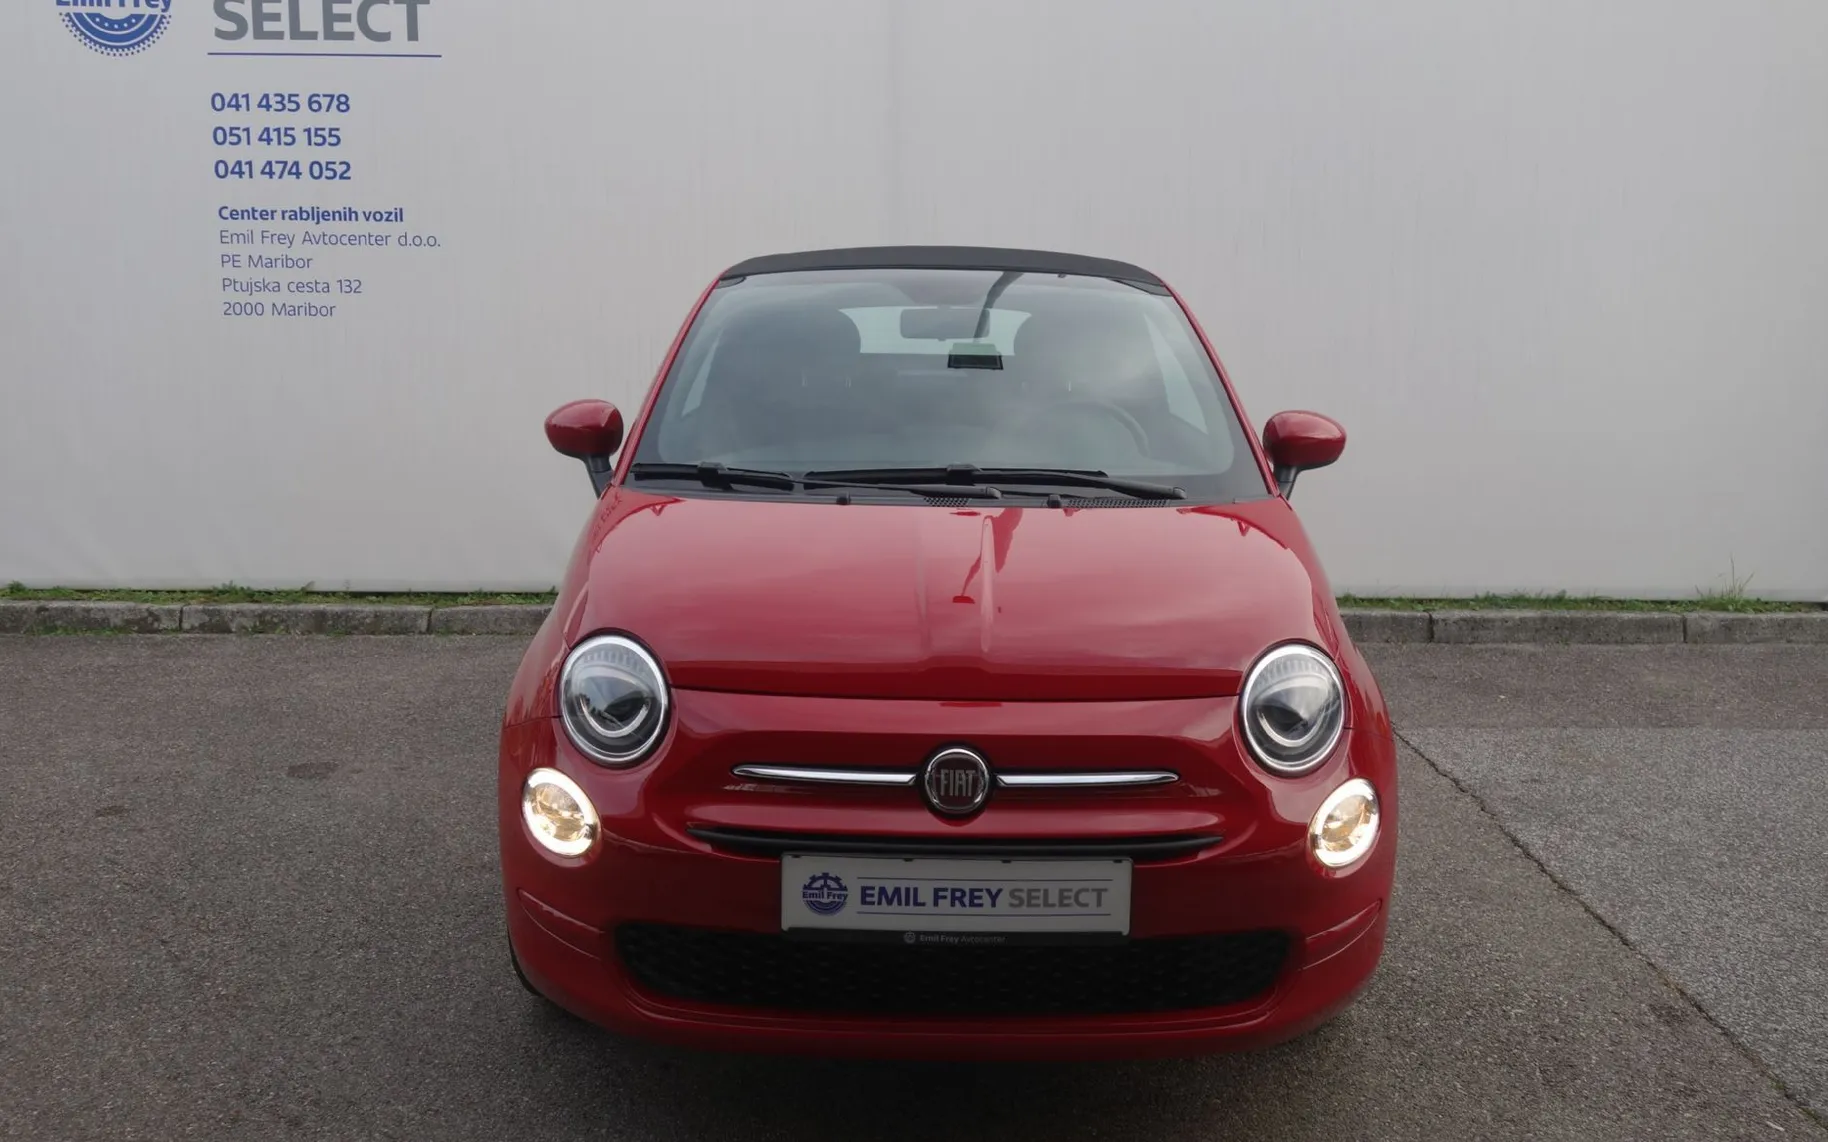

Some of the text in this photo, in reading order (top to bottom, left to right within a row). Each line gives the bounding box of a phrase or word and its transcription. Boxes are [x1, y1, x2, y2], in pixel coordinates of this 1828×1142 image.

[213, 0, 430, 43] SELECT
[210, 92, 351, 113] 041 435 678
[212, 126, 342, 147] 051 415 155
[214, 160, 352, 181] 041 474 052
[218, 205, 404, 226] Center rabljenih vozil
[219, 229, 441, 249] Emil Frey Avtocenter d.o.o.
[220, 254, 314, 269] PE Maribor
[222, 277, 363, 297] Ptujska cesta 132
[223, 301, 337, 318] 2000 Maribor
[941, 768, 976, 797] FIAT
[802, 891, 849, 902] Emil Frey
[860, 886, 1109, 909] EMIL FREY SELECT
[919, 934, 939, 942] Emil
[940, 934, 960, 944] Frey
